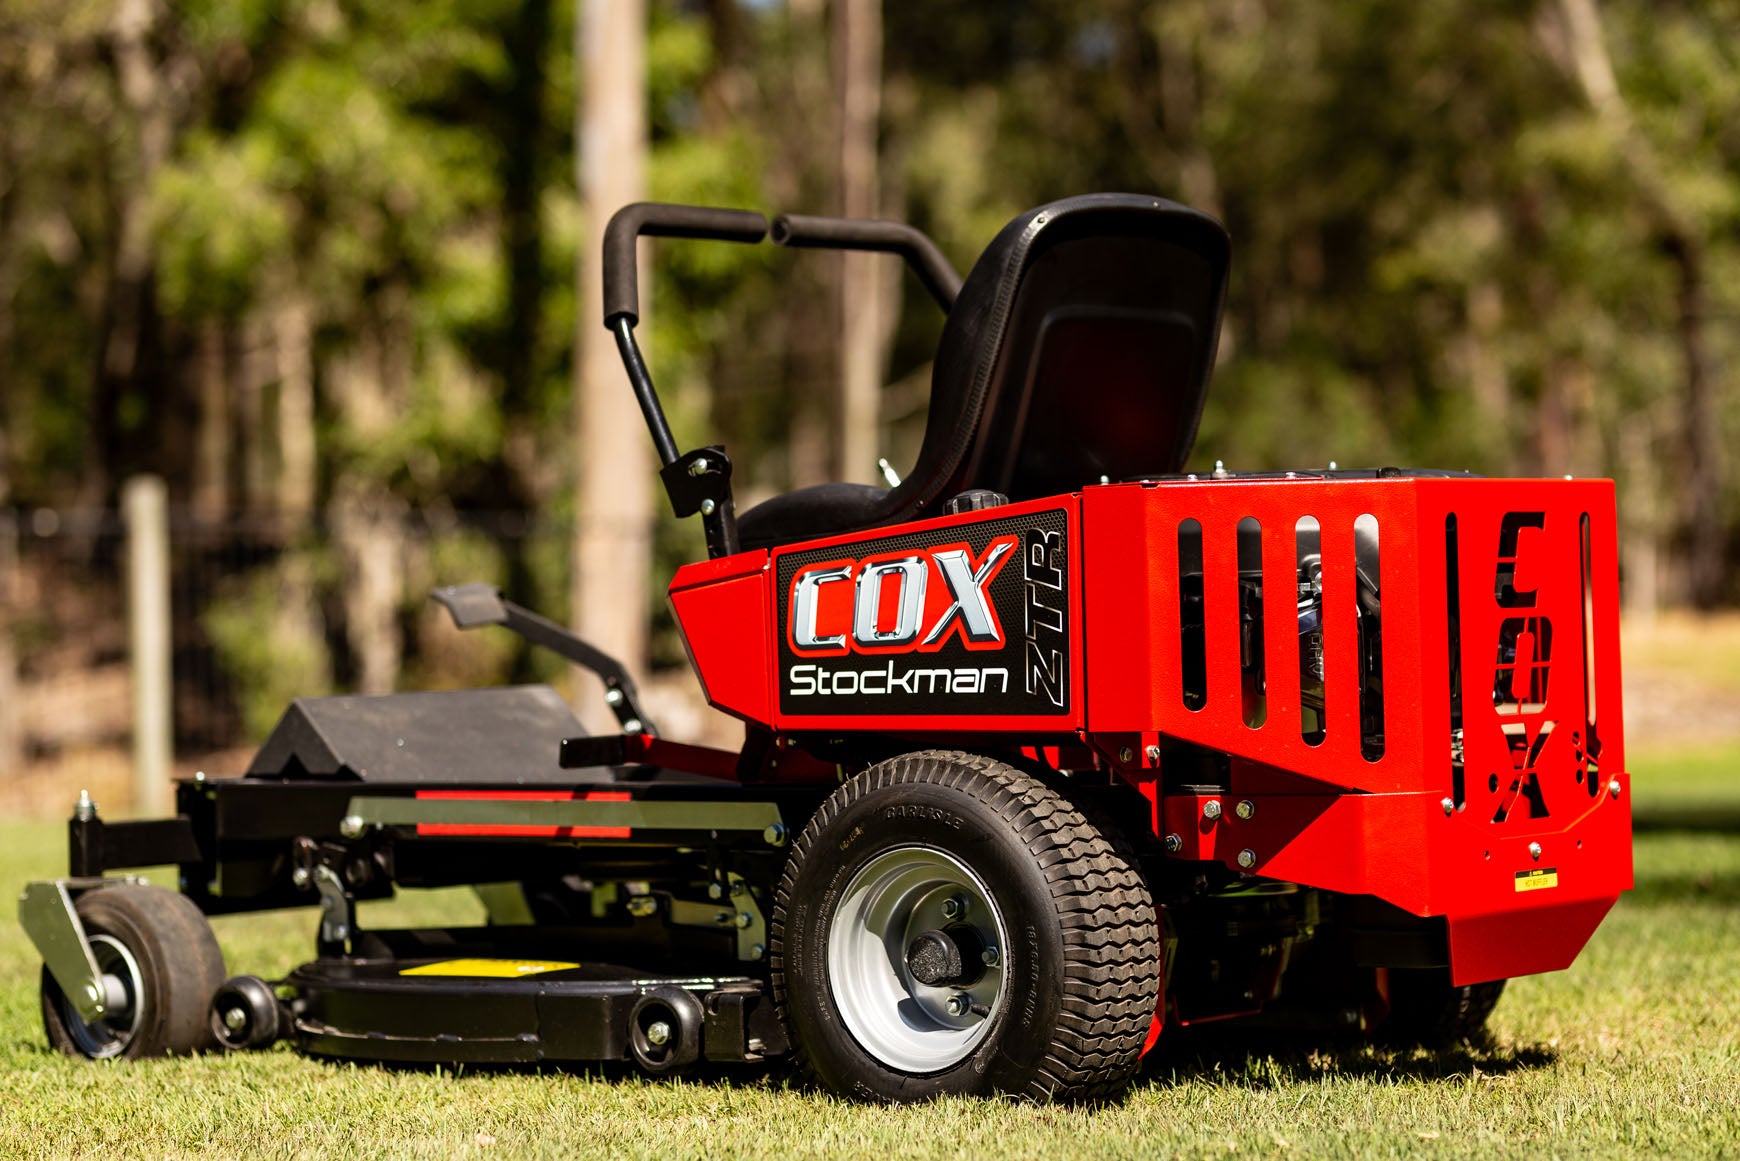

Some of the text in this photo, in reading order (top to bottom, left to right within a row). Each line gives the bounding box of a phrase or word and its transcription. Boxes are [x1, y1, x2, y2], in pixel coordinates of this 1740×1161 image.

[791, 542, 1014, 650] COX
[1025, 528, 1063, 707] ZTR
[1490, 511, 1559, 824] COX
[790, 660, 1008, 695] Stockman
